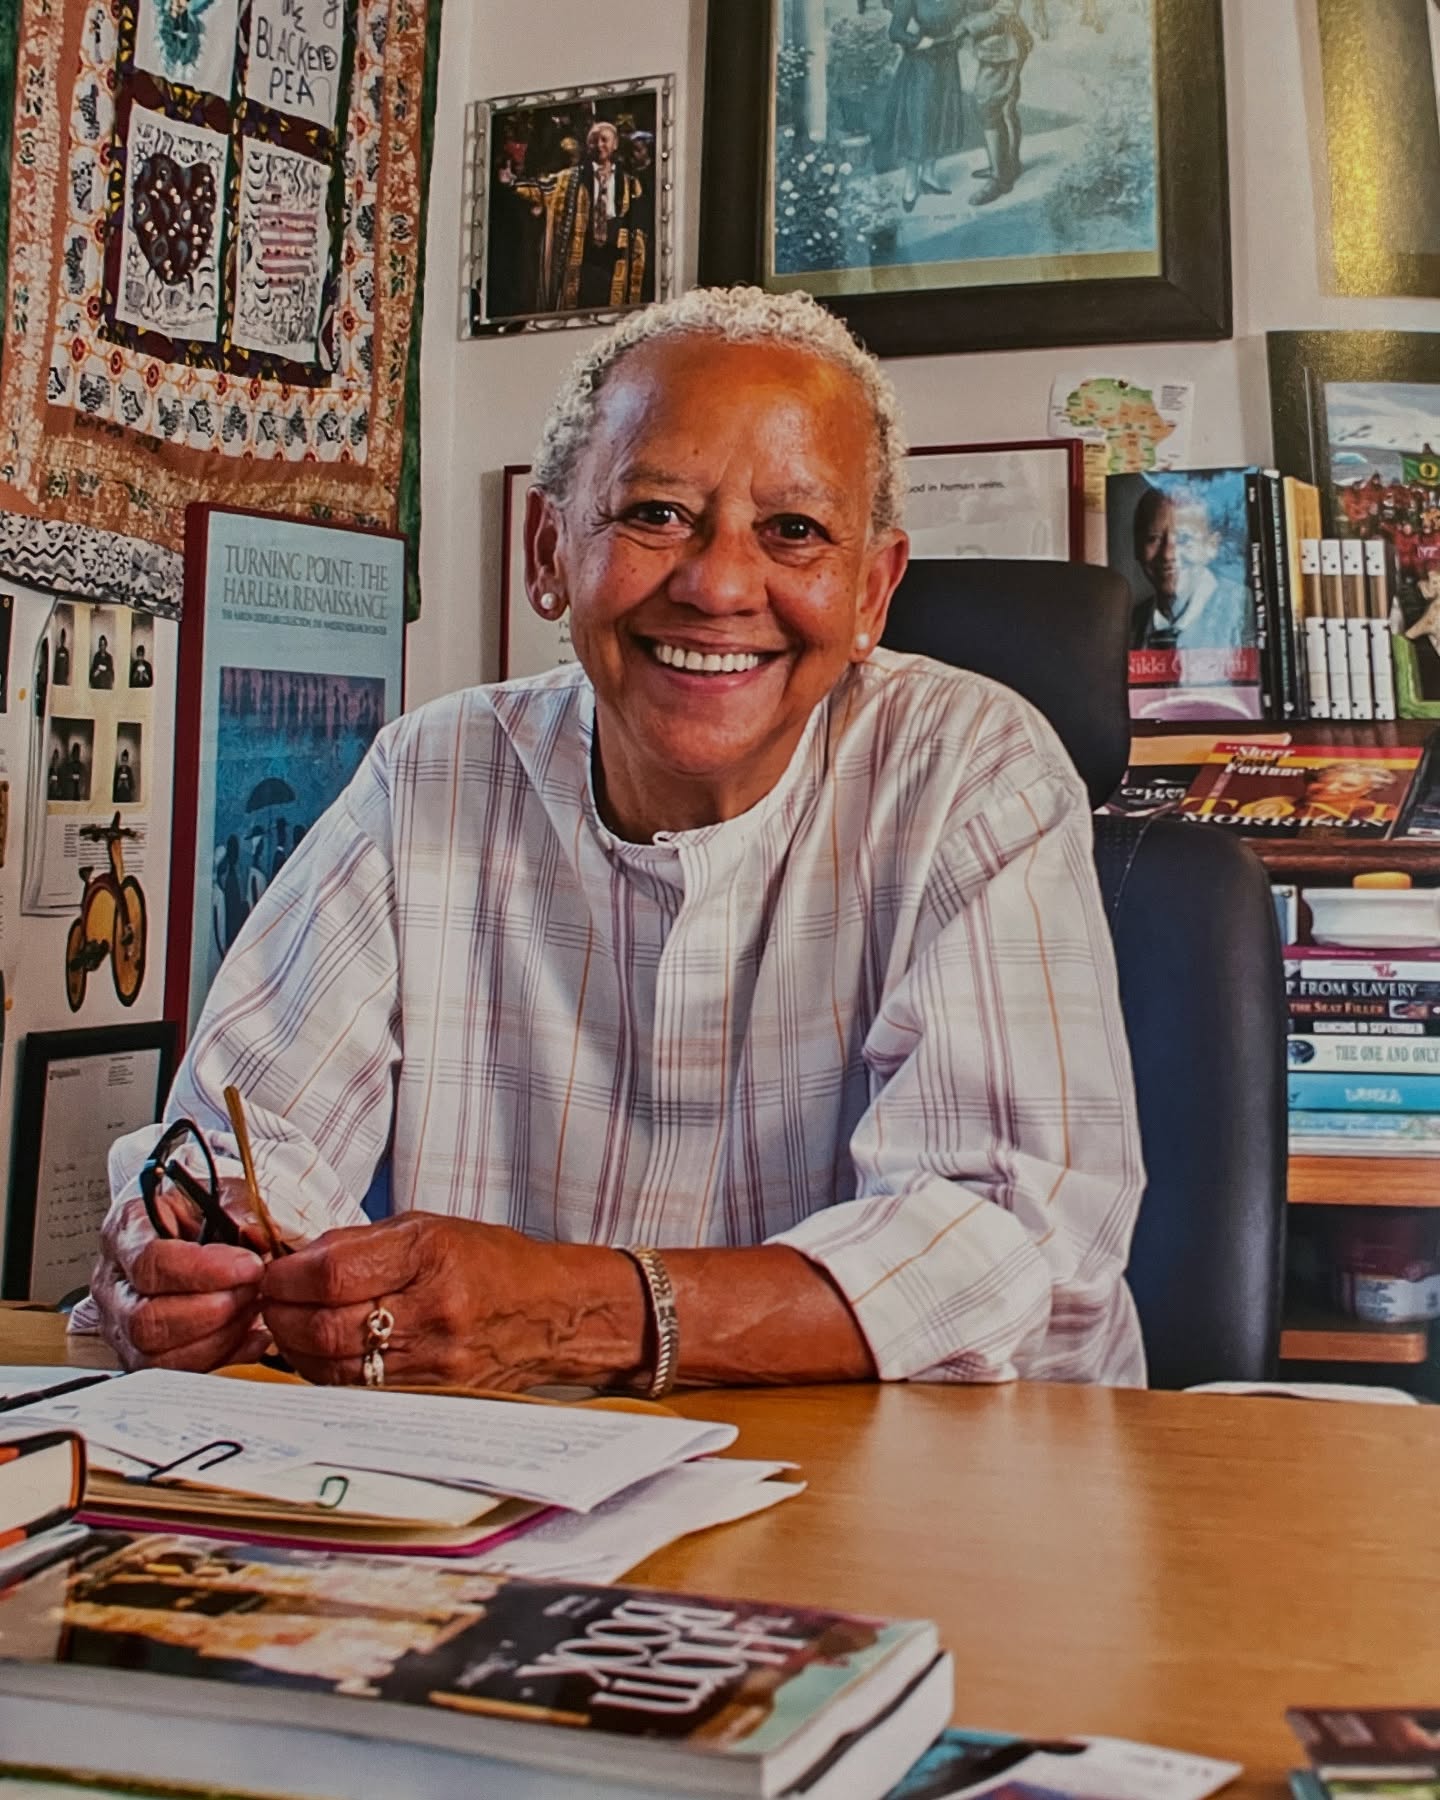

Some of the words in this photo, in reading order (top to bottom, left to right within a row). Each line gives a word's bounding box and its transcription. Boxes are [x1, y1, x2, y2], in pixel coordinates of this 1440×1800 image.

[269, 67, 315, 107] PEA
[940, 482, 975, 491] human
[225, 545, 300, 581] TURNING
[307, 556, 355, 588] POINT:
[360, 563, 389, 591] THE
[224, 577, 288, 609] HARLEM
[293, 585, 388, 620] RENAISSANCE
[1180, 796, 1400, 821] TONI
[1181, 811, 1390, 828] MORRISON
[1300, 981, 1348, 997] FROM
[1351, 981, 1418, 998] SLAVERY
[1289, 1002, 1312, 1014] THE
[1335, 1045, 1357, 1061] THE
[1360, 1045, 1383, 1062] ONE
[1386, 1046, 1409, 1062] AND
[1412, 1046, 1440, 1063] ONLY
